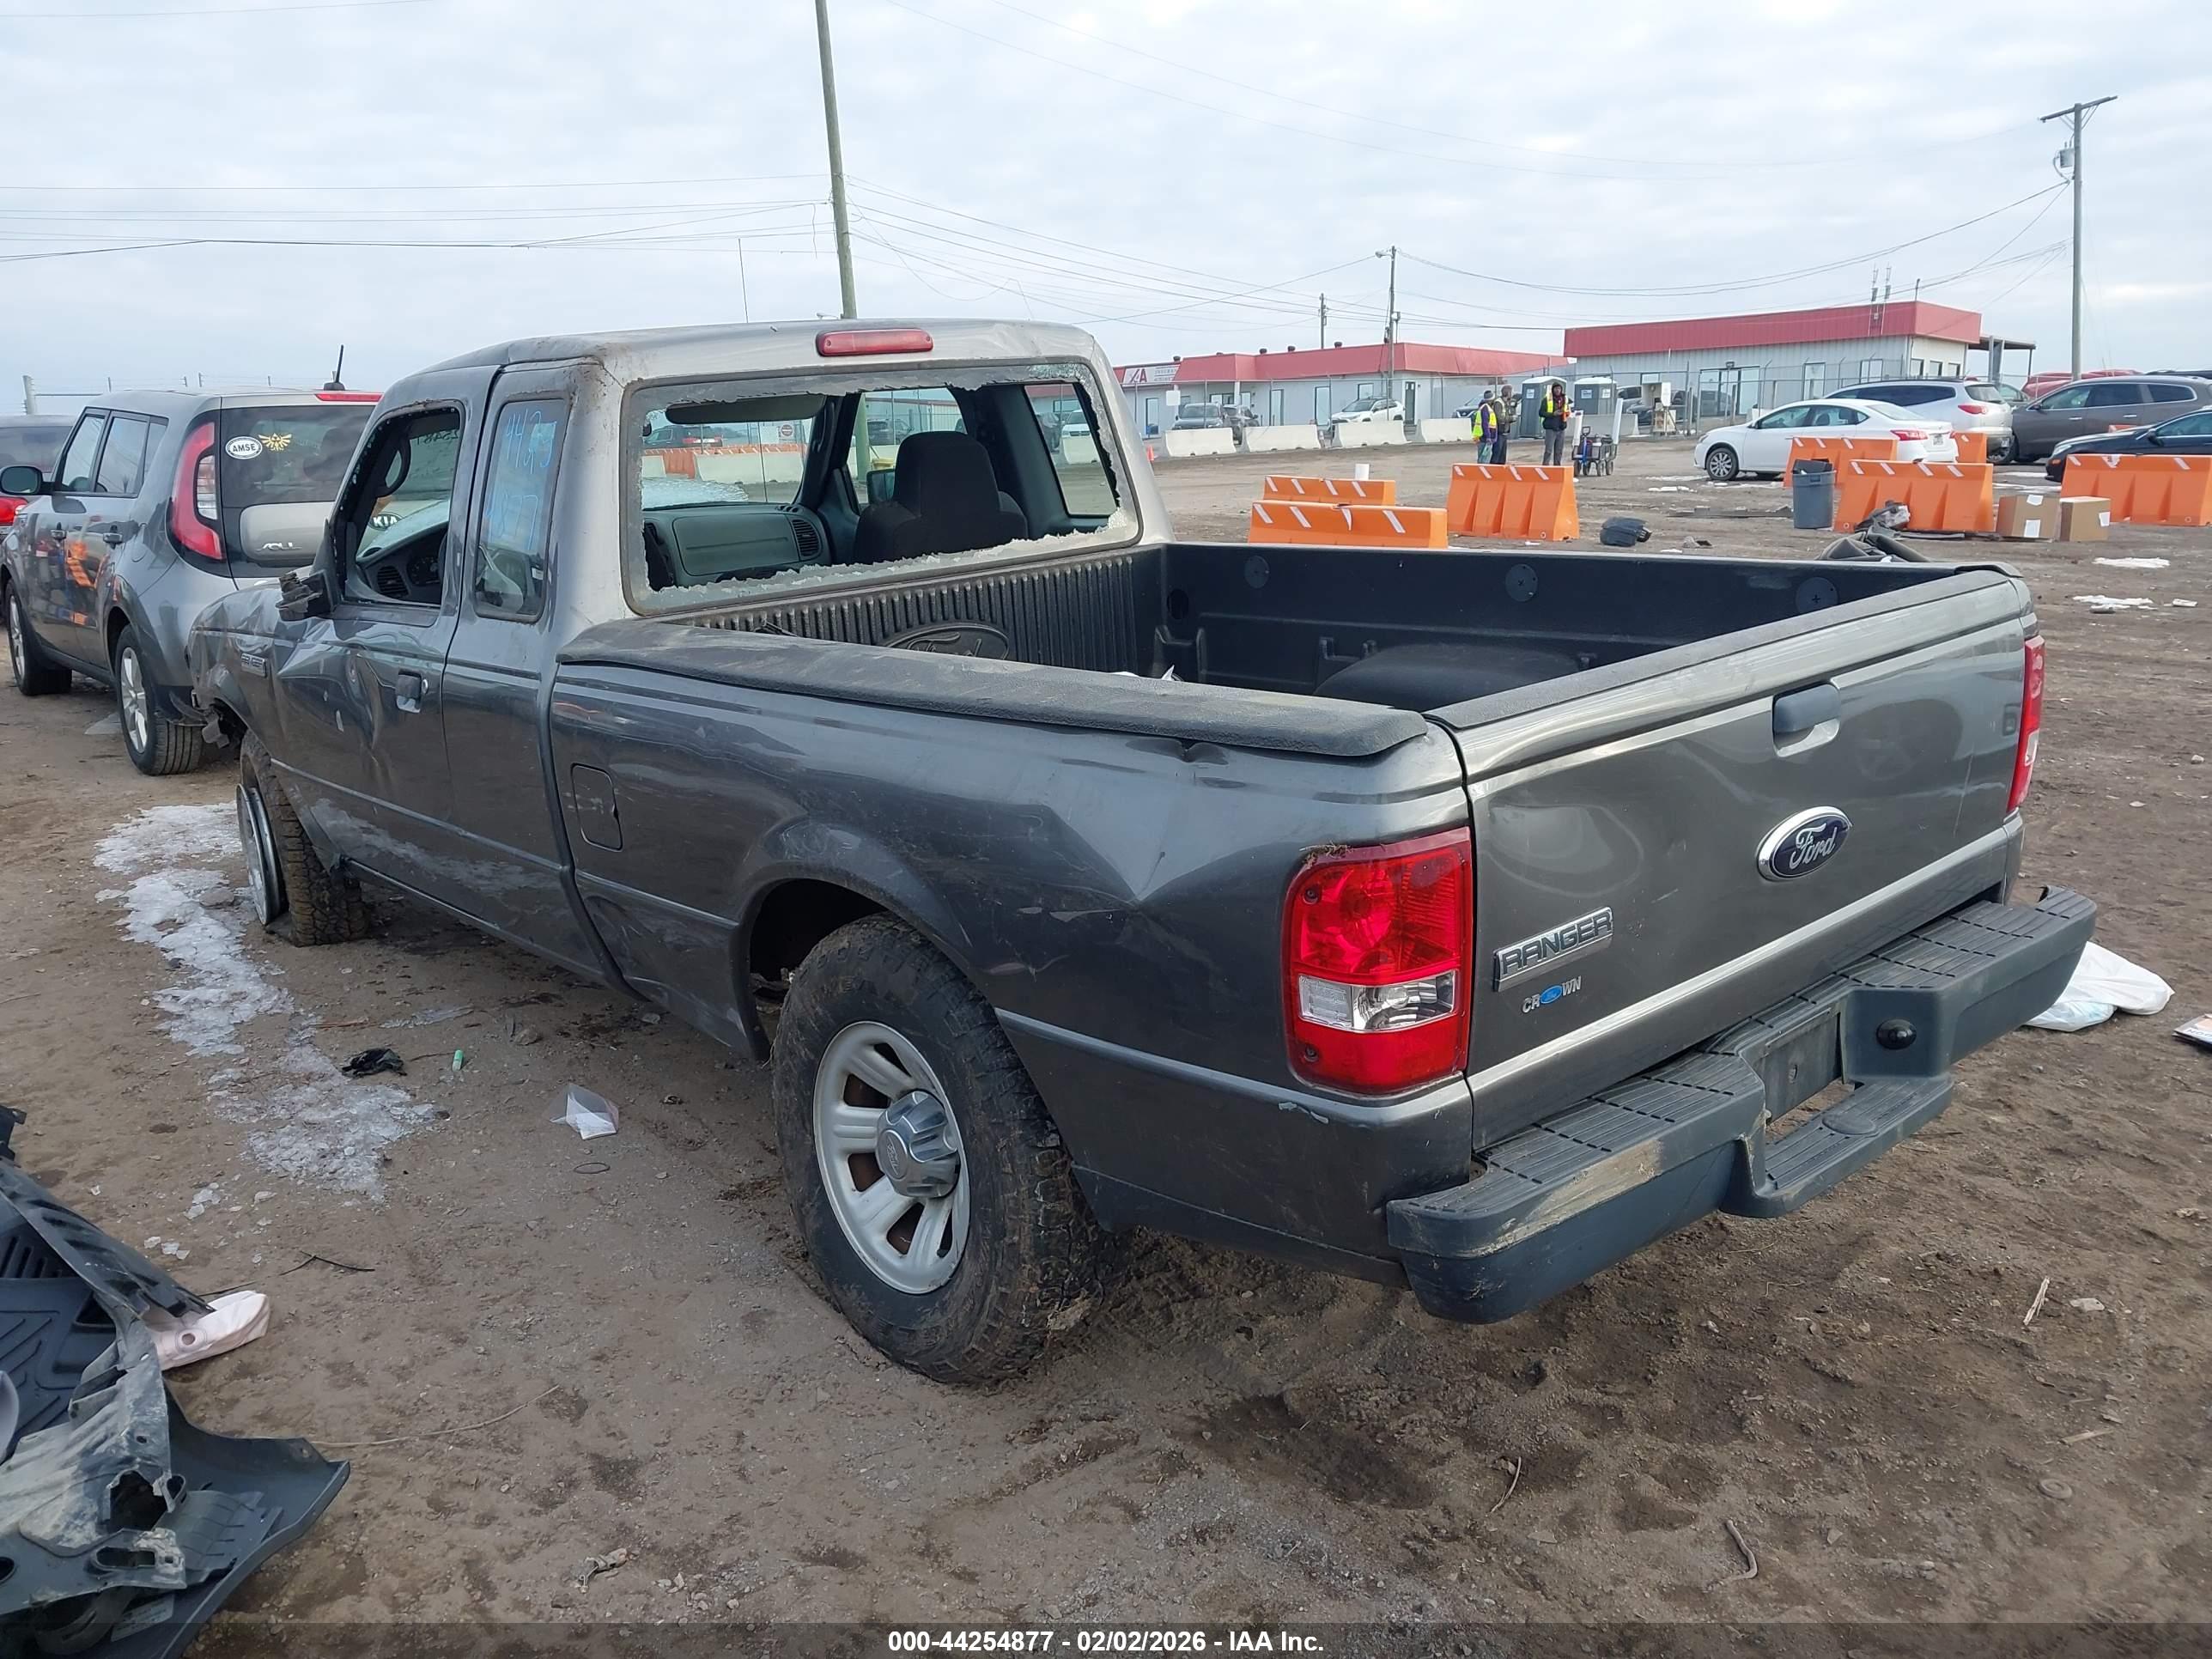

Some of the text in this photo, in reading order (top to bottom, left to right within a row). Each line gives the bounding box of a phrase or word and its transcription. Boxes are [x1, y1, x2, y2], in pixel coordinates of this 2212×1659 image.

[232, 443, 257, 453] AMSE
[373, 515, 398, 527] KIA
[1789, 823, 1838, 870] Ford
[1502, 910, 1613, 975] RANGER
